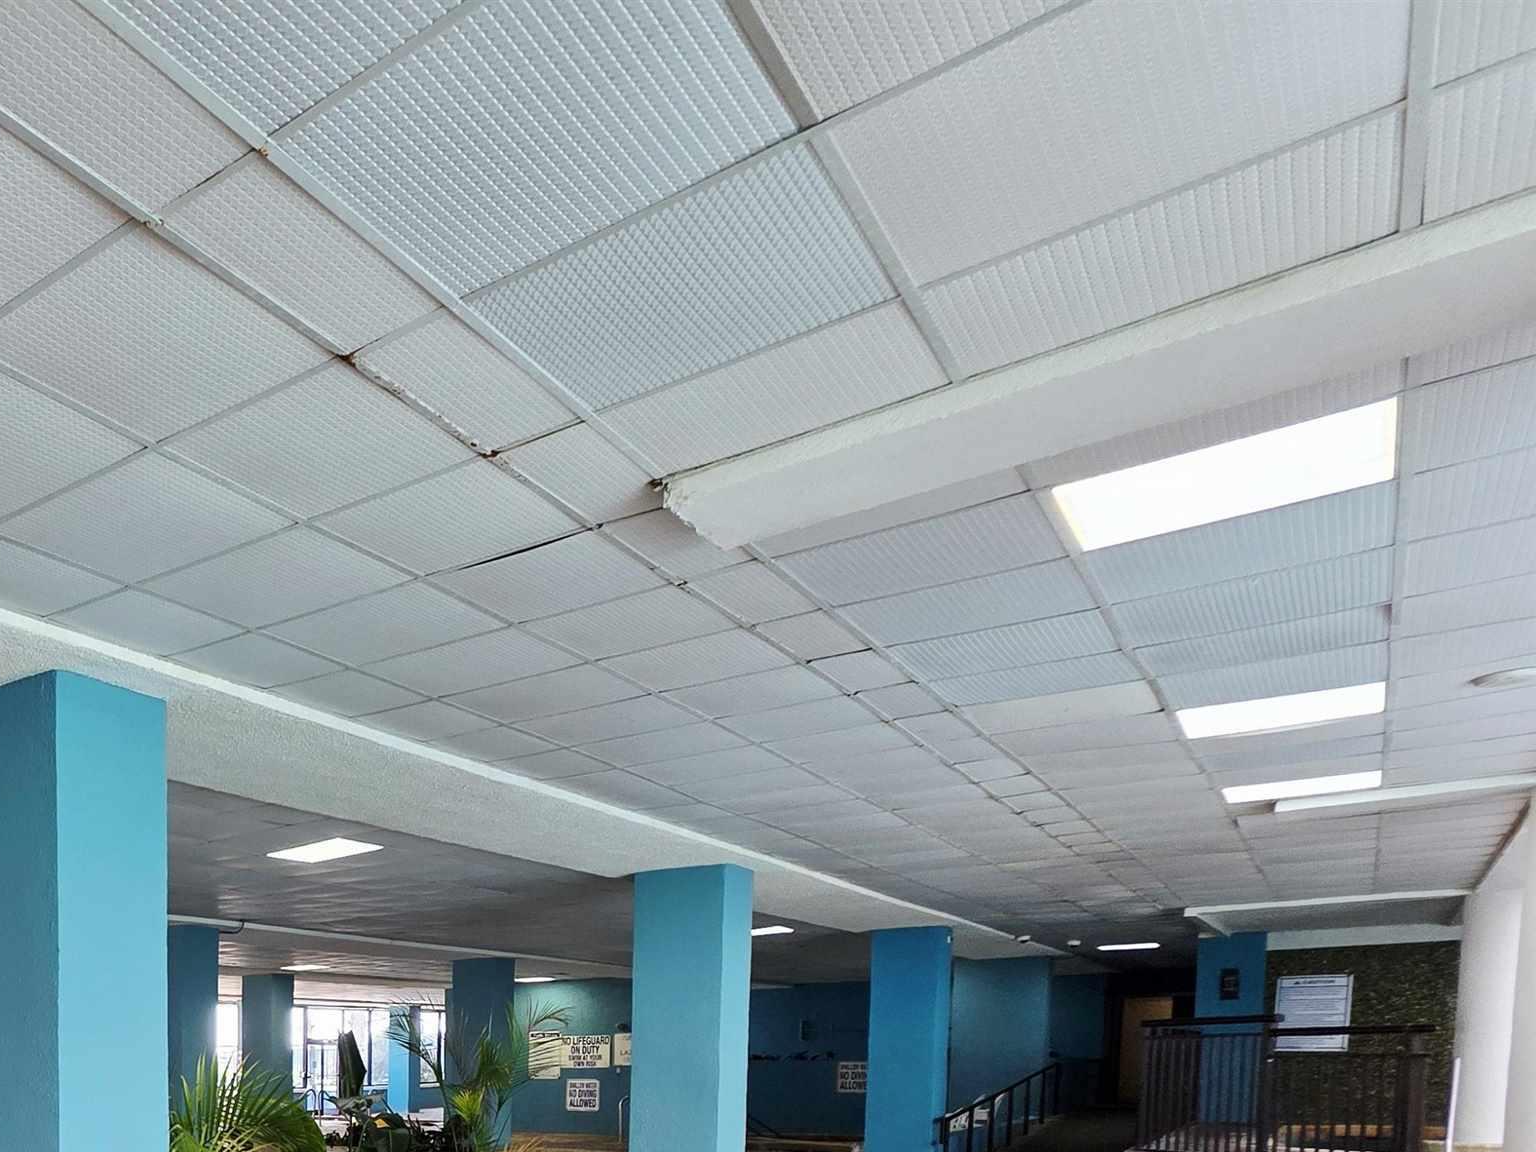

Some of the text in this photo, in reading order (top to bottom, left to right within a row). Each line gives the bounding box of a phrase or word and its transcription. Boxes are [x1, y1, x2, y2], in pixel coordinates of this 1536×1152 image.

[573, 1036, 609, 1045] LIFEGUARD
[571, 1045, 599, 1054] ON DUTY
[840, 1071, 849, 1080] NO
[569, 1089, 597, 1098] NO DIVING
[569, 1098, 597, 1108] ALLOWED
